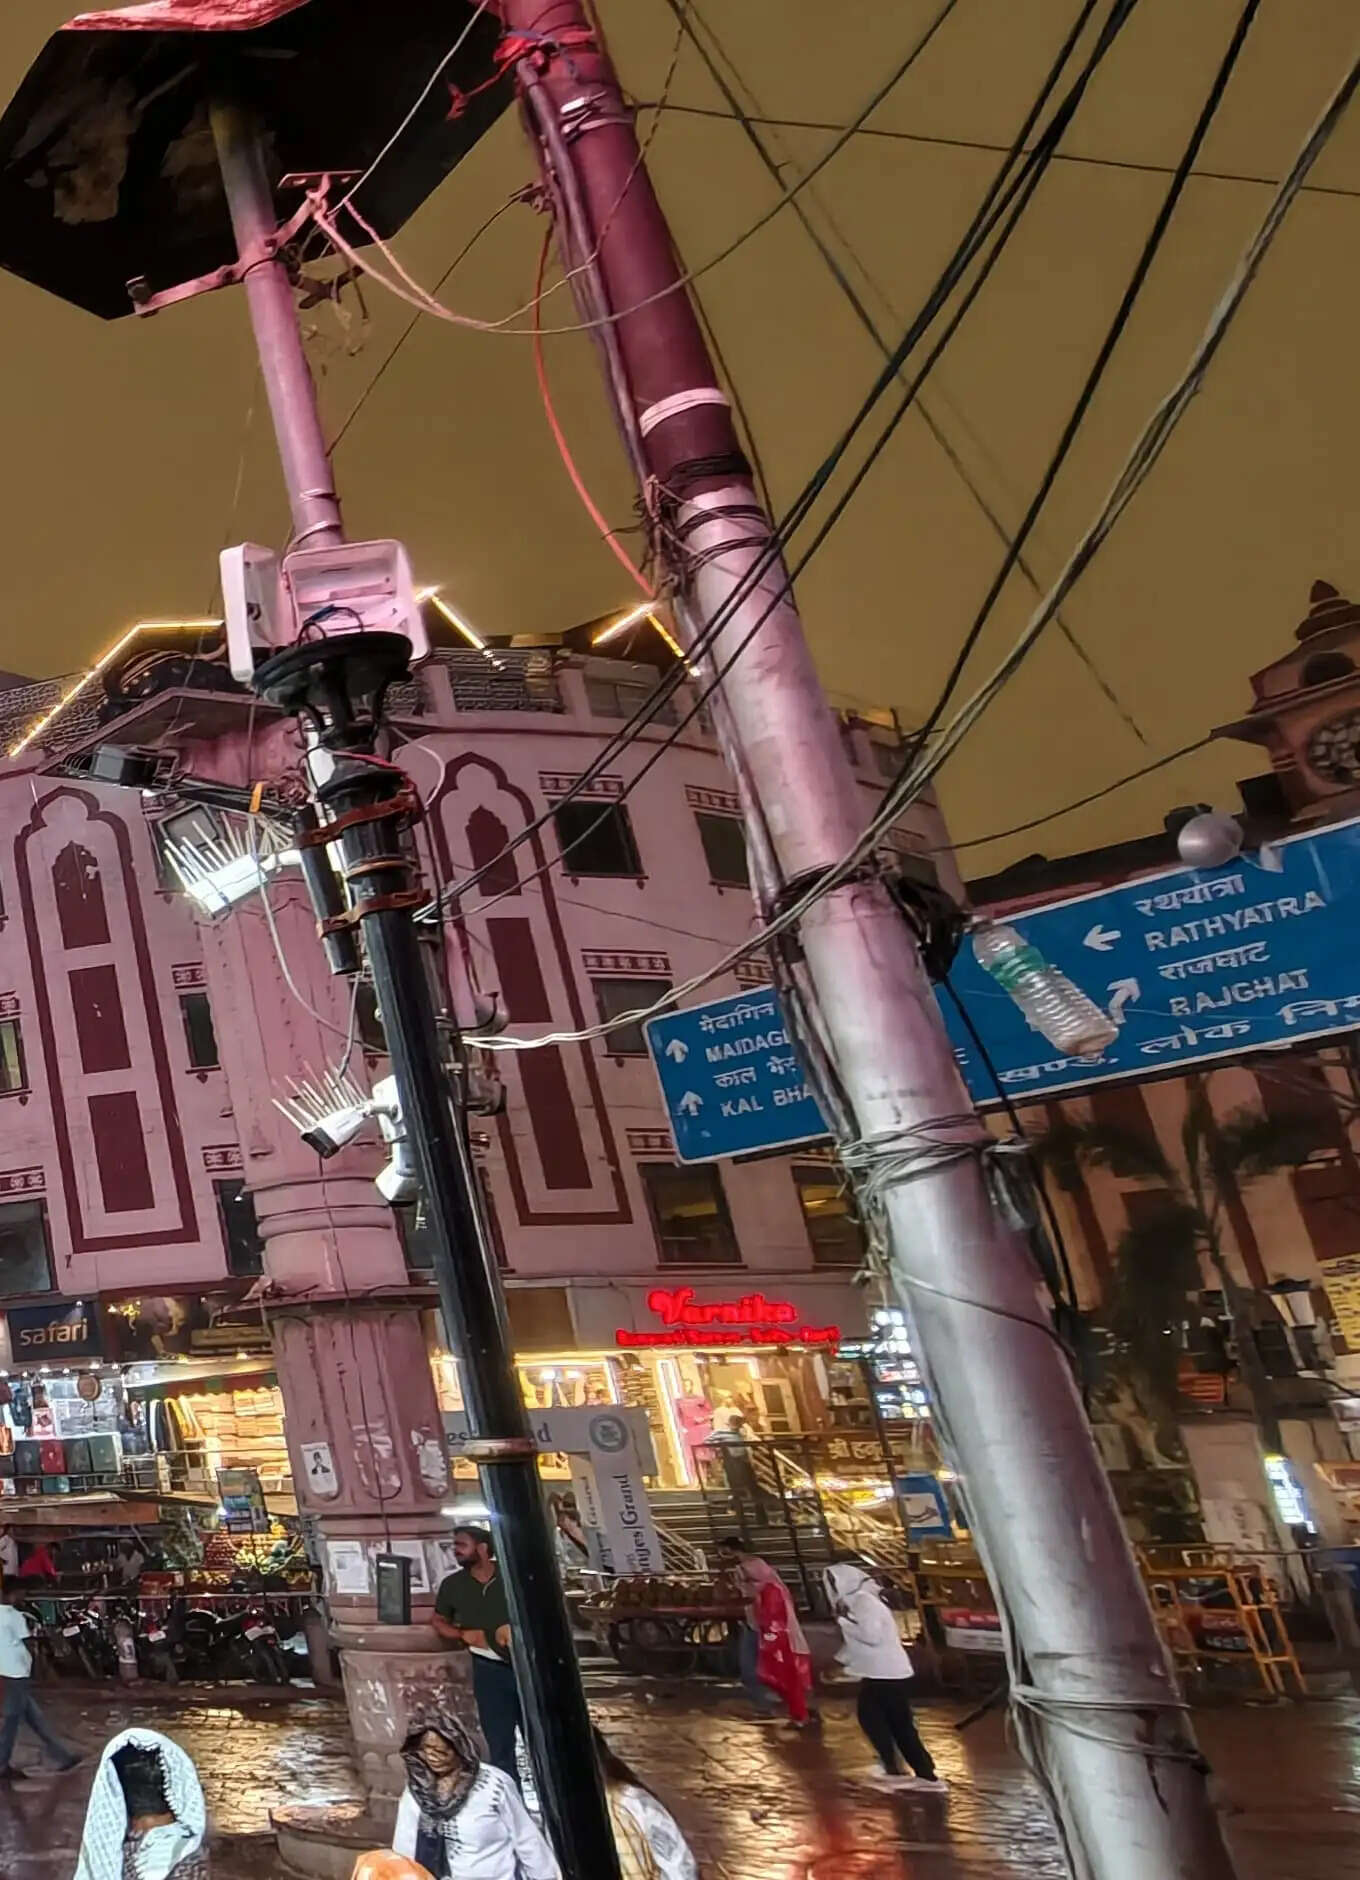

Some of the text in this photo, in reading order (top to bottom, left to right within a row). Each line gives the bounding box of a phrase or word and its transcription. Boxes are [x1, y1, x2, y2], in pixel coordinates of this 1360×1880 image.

[1144, 890, 1327, 951] RATHYATRA
[1157, 941, 1271, 980] राजघाट
[1169, 968, 1310, 1016] RAJGHAT
[705, 1028, 791, 1063] MAIDAGI
[1135, 1018, 1252, 1056] लोक
[712, 1066, 757, 1088] काल
[720, 1084, 815, 1117] KAL BHA
[19, 1317, 88, 1347] safari
